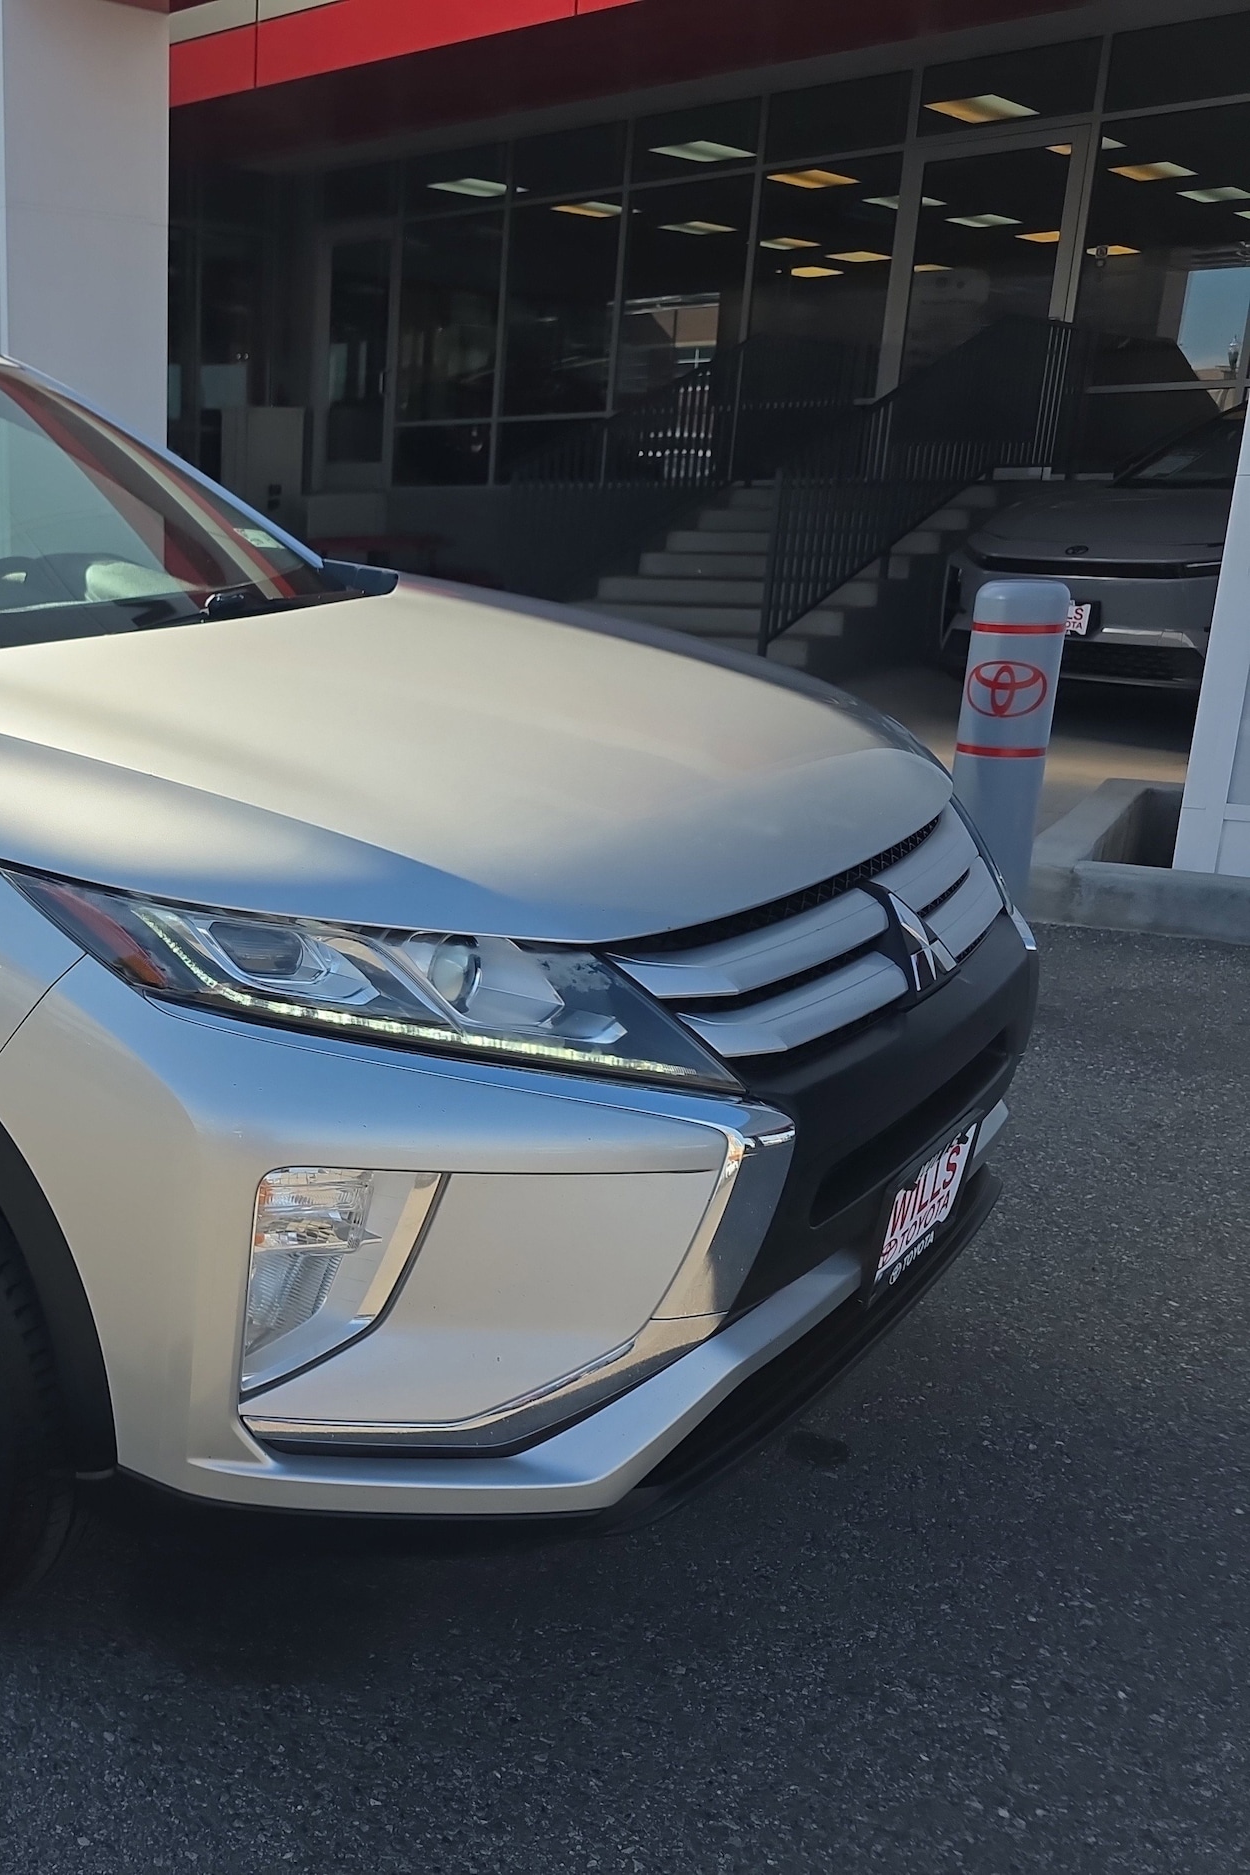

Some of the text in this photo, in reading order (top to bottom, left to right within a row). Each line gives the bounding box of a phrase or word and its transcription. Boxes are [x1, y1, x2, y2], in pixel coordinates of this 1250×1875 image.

[890, 1144, 961, 1237] WILLS
[898, 1190, 949, 1253] TOYOTA
[902, 1230, 935, 1271] TOYOTA
